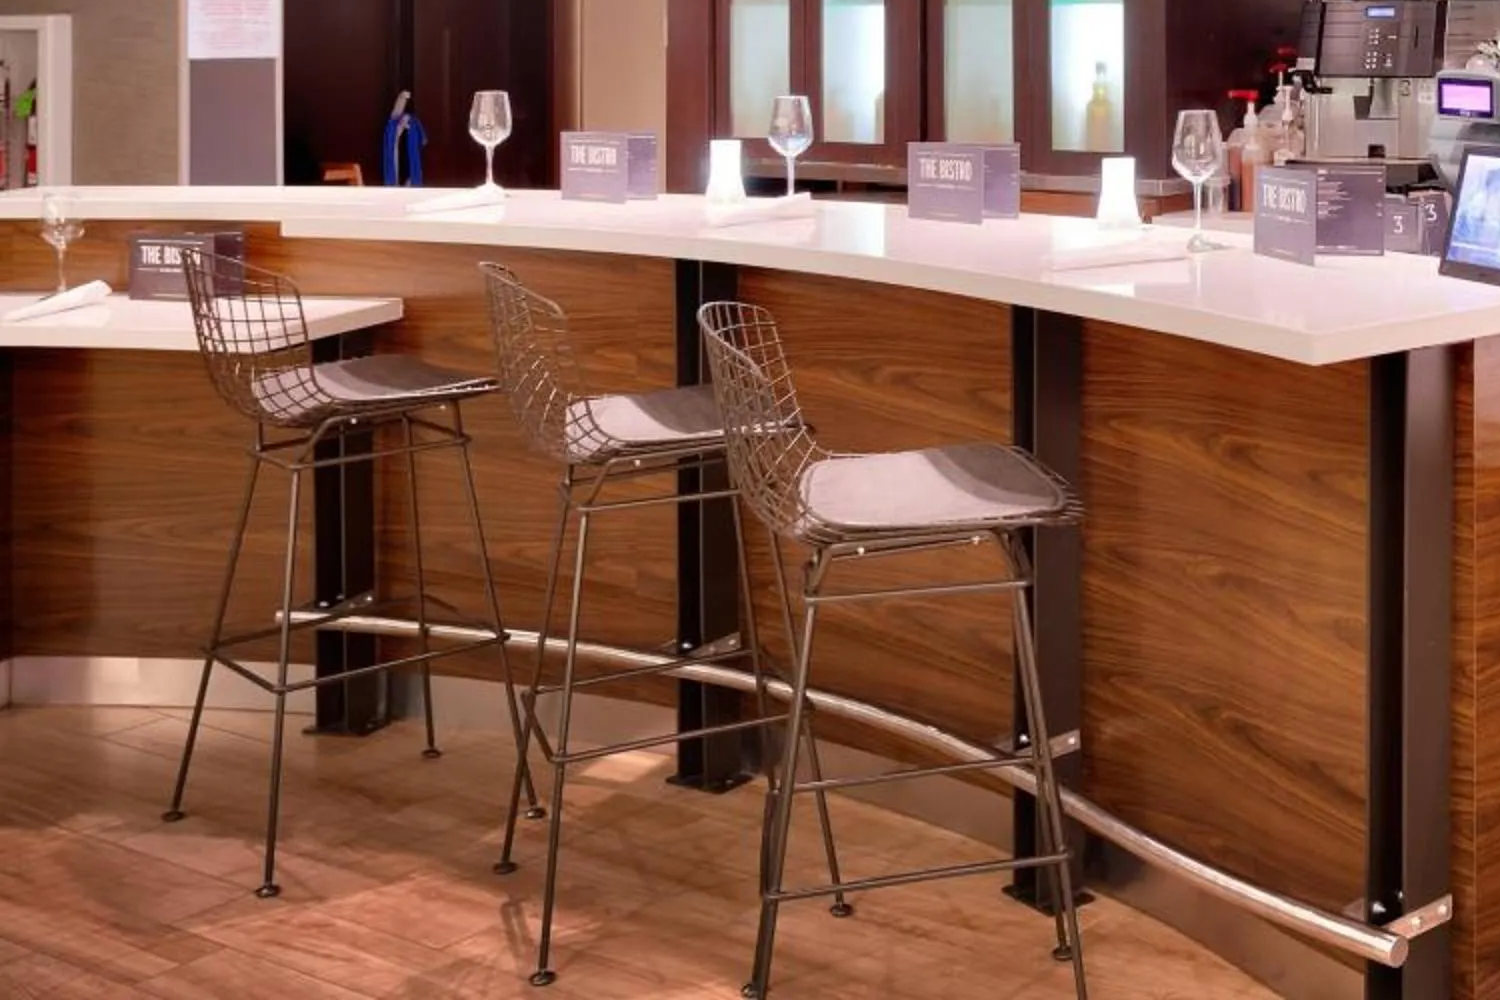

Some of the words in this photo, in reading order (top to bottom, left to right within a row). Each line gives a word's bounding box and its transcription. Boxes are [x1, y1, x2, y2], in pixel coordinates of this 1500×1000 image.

[571, 144, 586, 165] THE
[588, 145, 618, 166] BISTRO
[919, 158, 937, 180] THE
[939, 159, 973, 182] BISTRO
[1263, 183, 1277, 209] THE
[1278, 185, 1308, 214] BISTRO
[140, 245, 162, 265] THE
